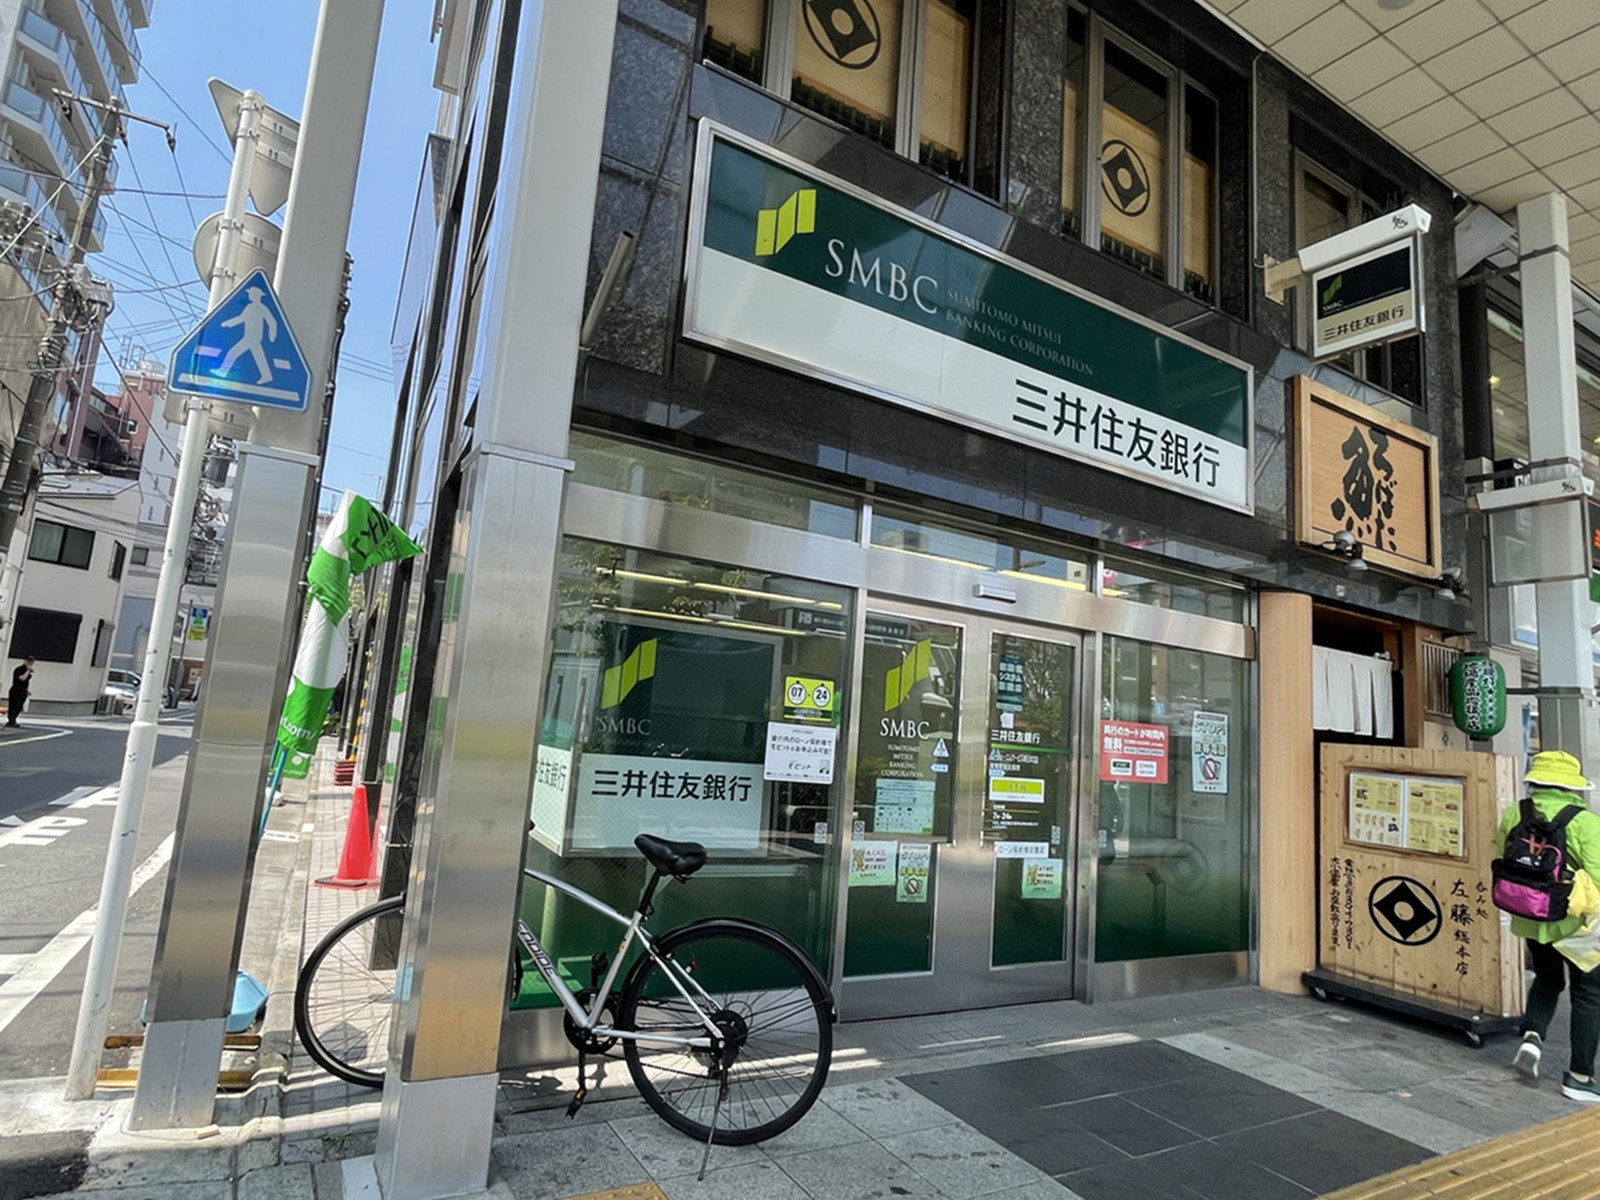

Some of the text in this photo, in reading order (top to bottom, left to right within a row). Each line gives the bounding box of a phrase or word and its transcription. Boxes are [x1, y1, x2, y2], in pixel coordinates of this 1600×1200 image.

[825, 239, 938, 314] SMBC
[947, 291, 1062, 346] SUMITOMO MITSUI
[1323, 305, 1405, 341] 三井住友銀行
[946, 311, 1094, 377] BANKING CORPORATION
[1012, 379, 1221, 487] 三井住友銀行
[791, 687, 828, 701] 07 24
[599, 715, 651, 736] SMBC
[880, 717, 930, 739] SMBC
[991, 729, 1040, 744] 三井住友銀行
[592, 769, 752, 802] 三井住友銀行
